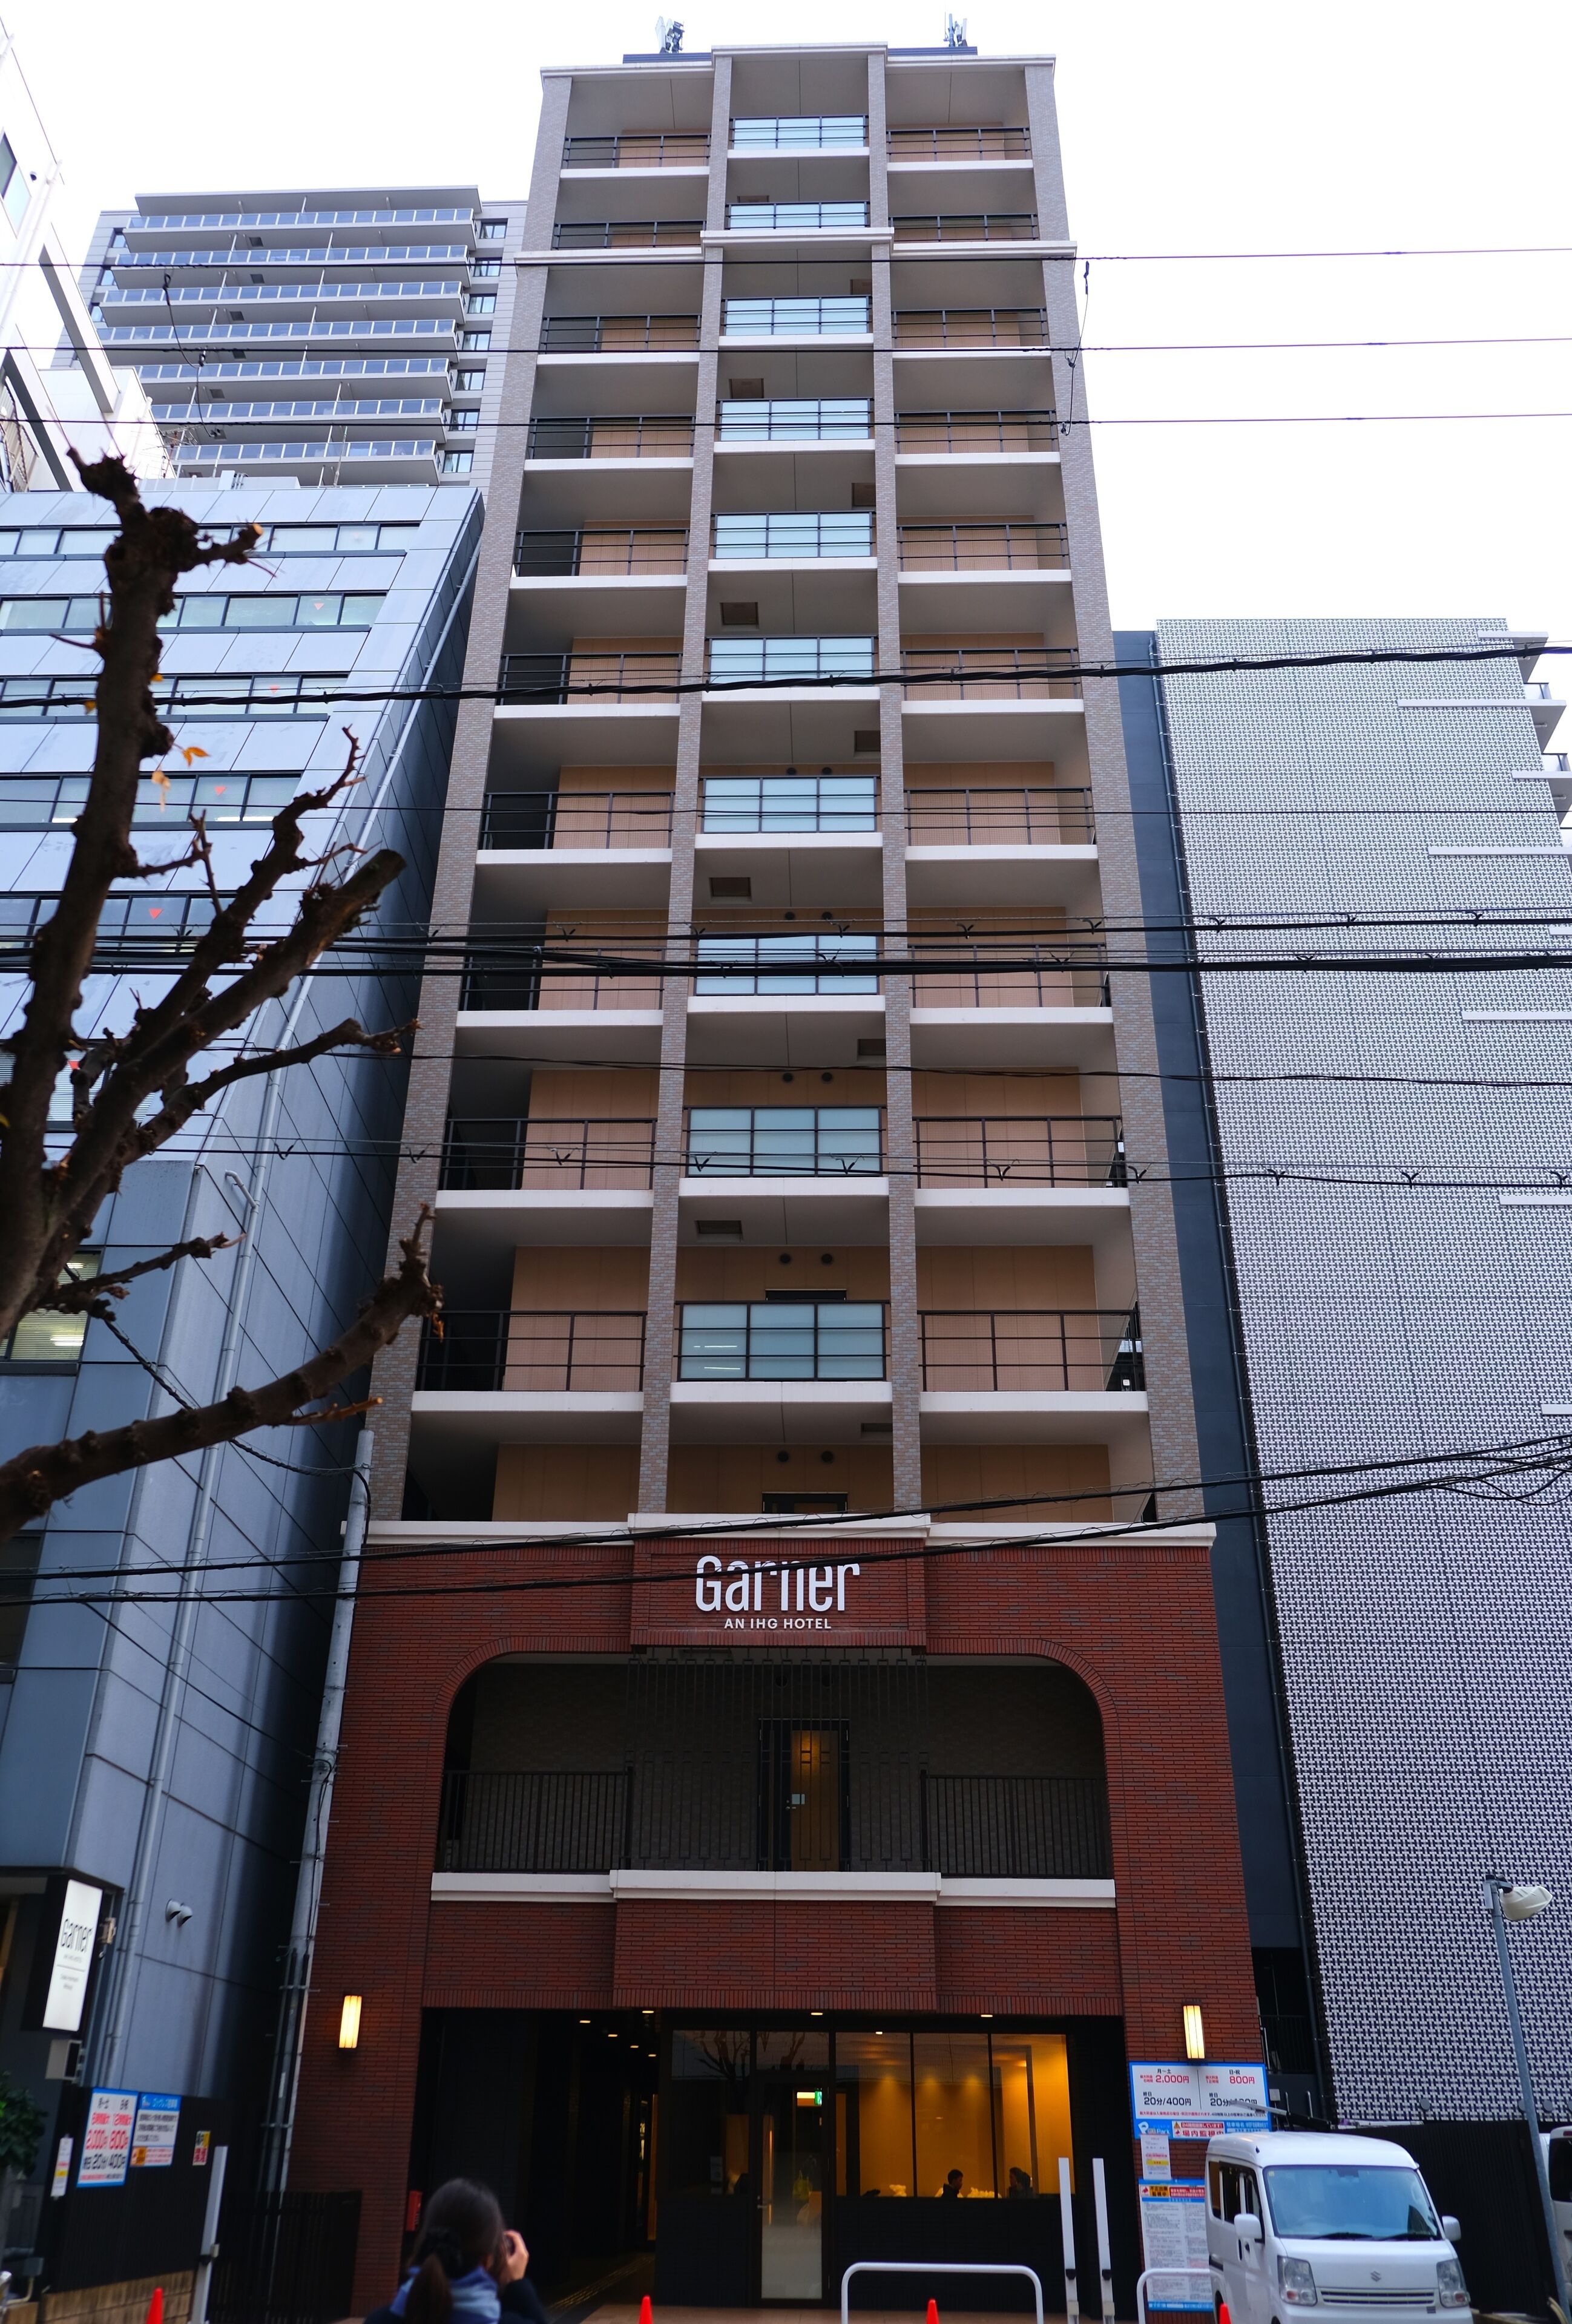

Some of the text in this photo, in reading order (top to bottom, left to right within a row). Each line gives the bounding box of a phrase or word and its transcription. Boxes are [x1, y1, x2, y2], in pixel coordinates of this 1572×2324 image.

[696, 1555, 860, 1611] Garner
[724, 1618, 832, 1629] AN IHG HOTEL
[61, 1918, 93, 1953] Garner
[1156, 2075, 1189, 2083] 2,000円
[1144, 2097, 1191, 2106] 20分/400円
